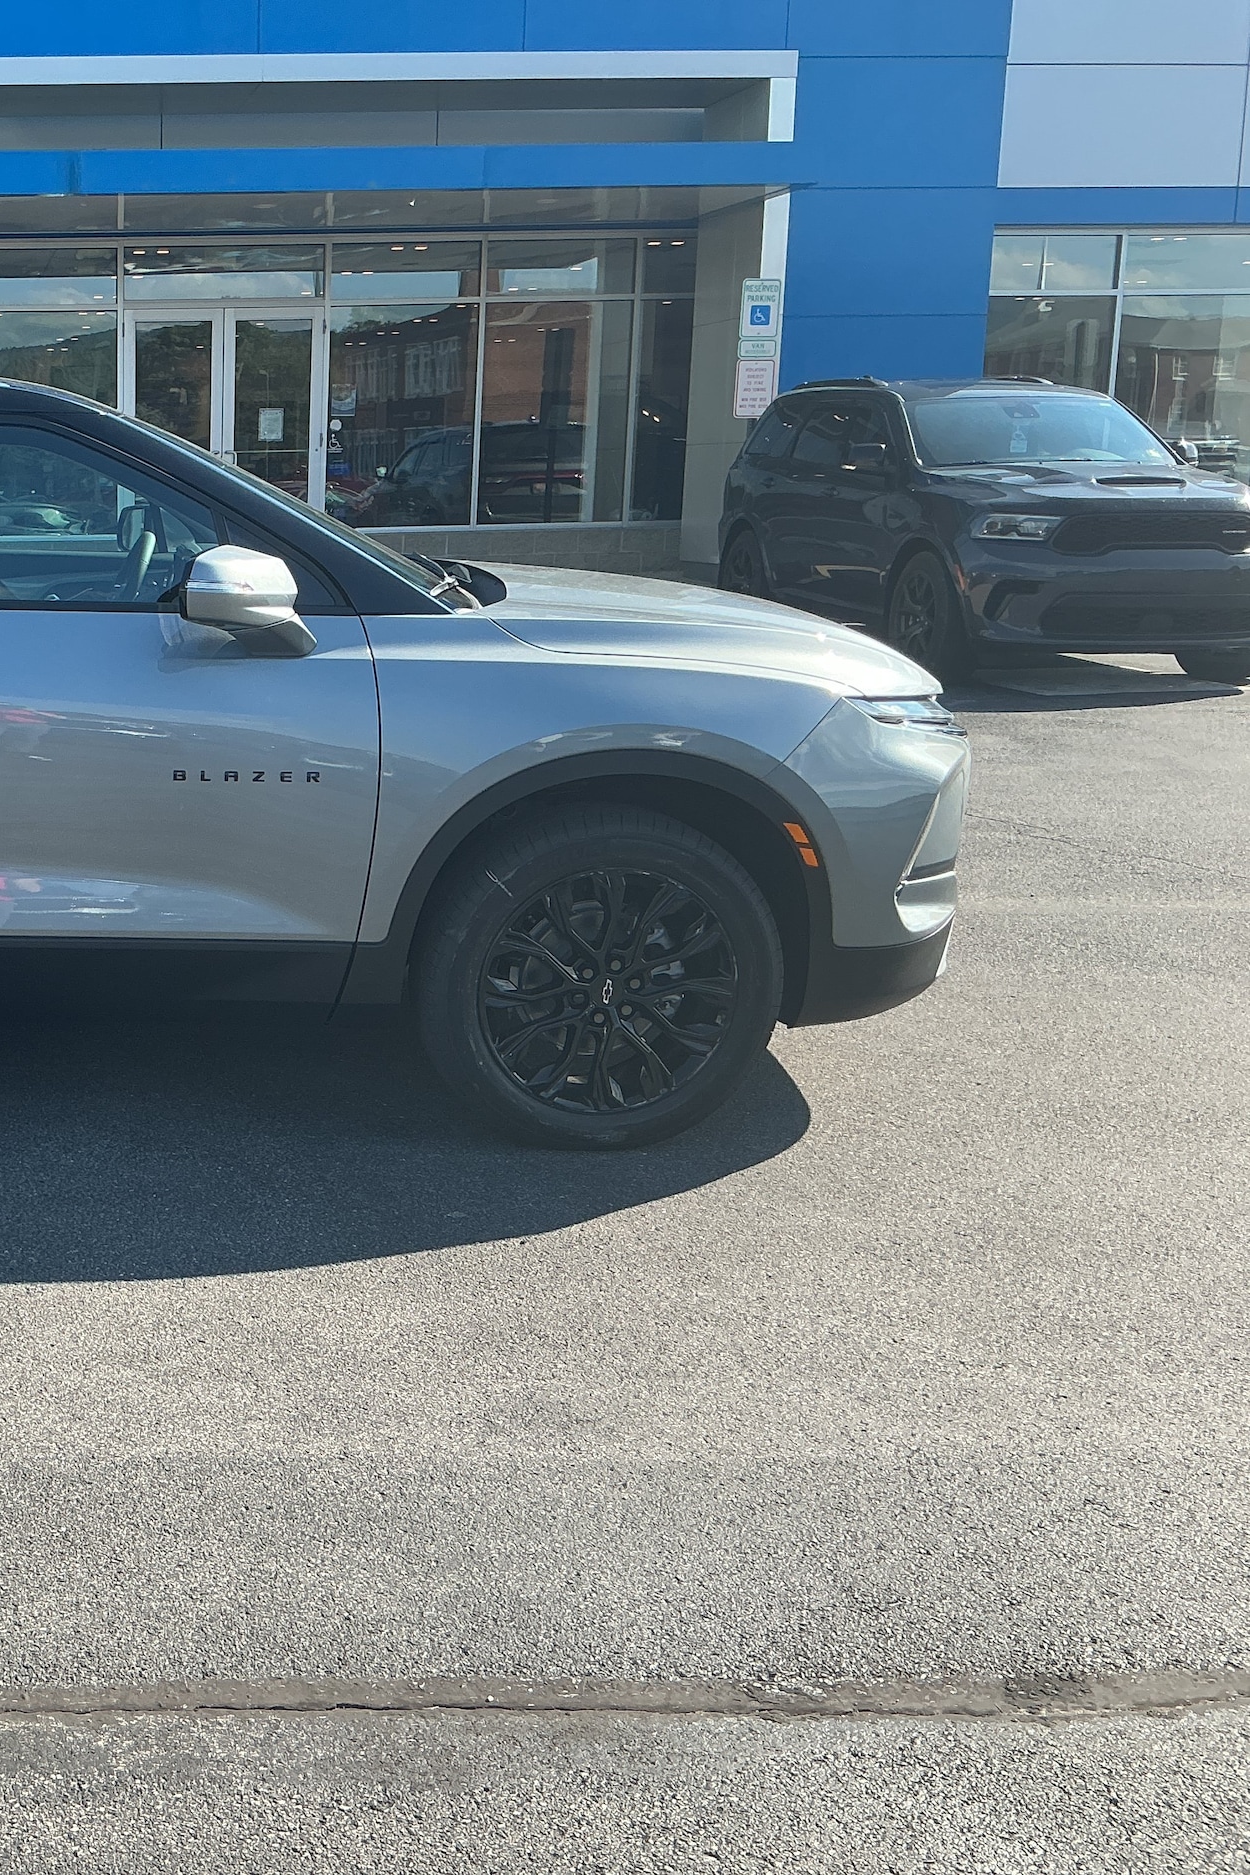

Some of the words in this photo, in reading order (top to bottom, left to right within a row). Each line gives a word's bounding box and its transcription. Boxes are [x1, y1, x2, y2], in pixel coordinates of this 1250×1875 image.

[745, 284, 779, 293] RESERVED
[747, 294, 776, 303] PARKING
[172, 769, 321, 783] BLAZER
